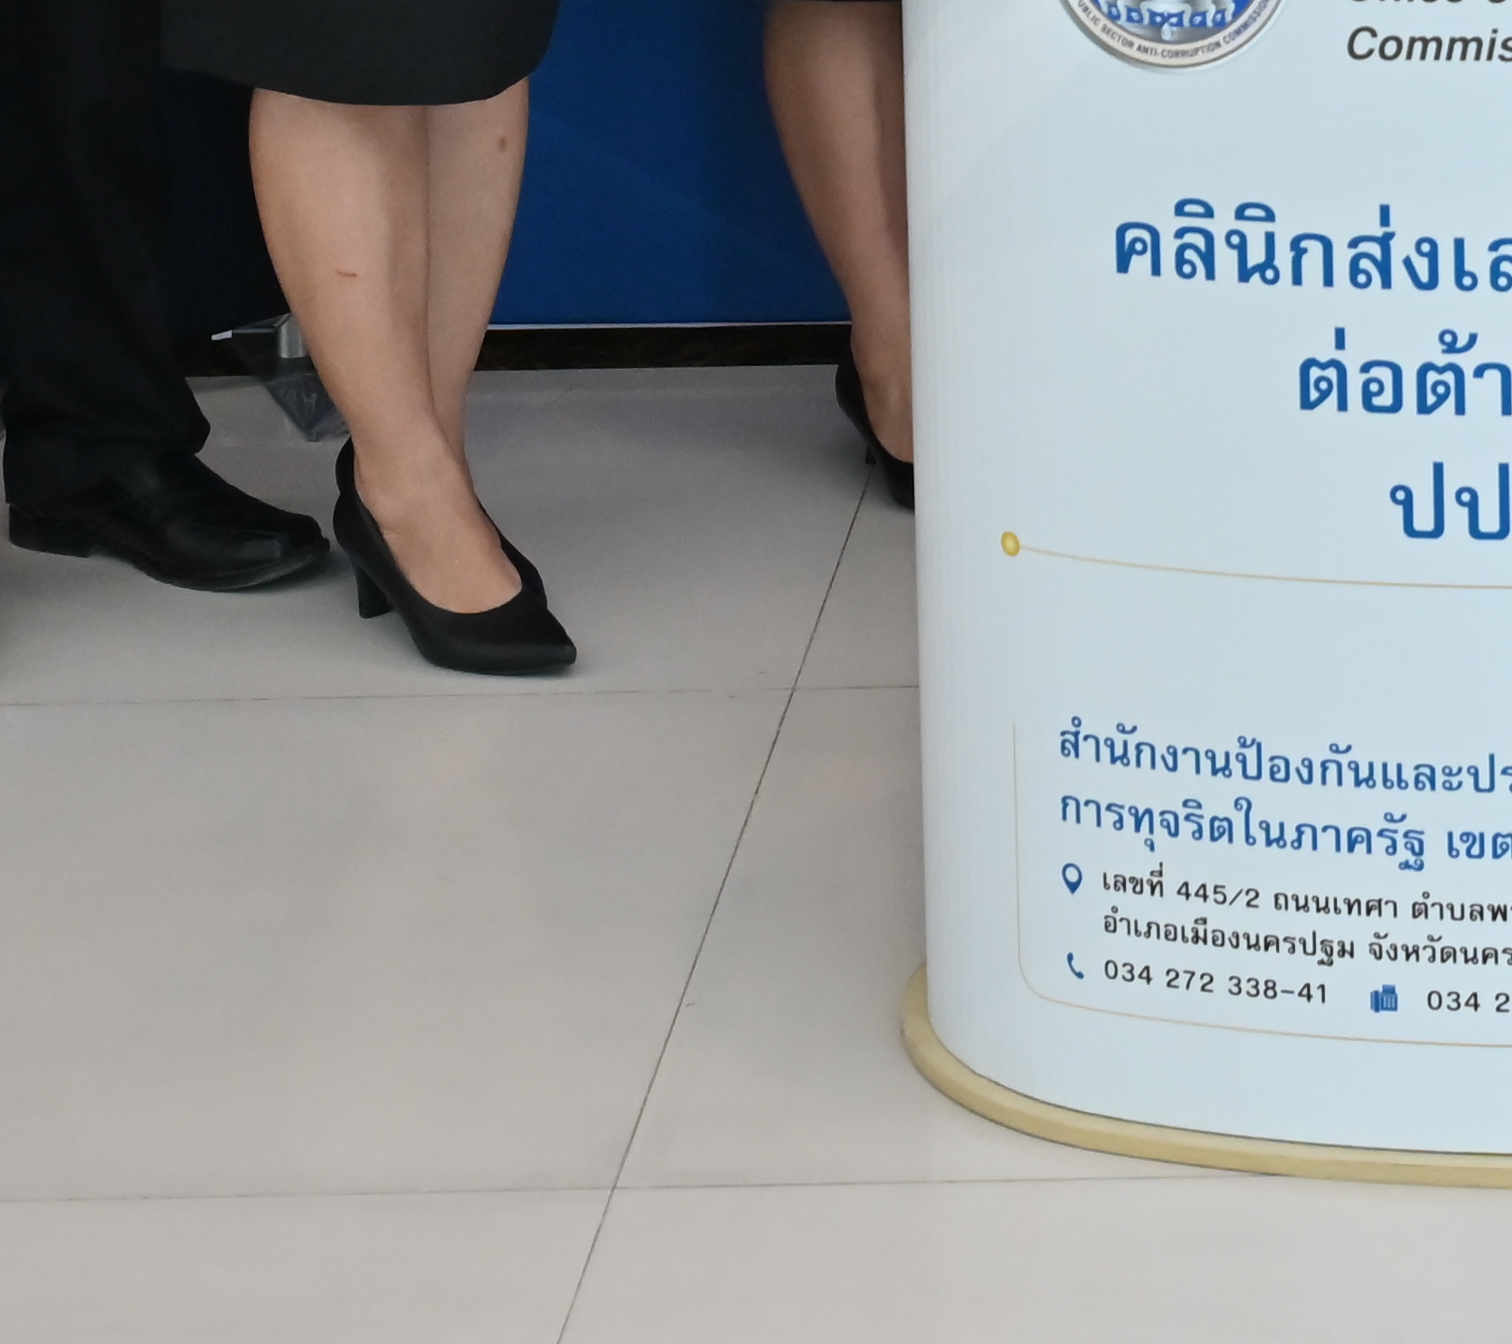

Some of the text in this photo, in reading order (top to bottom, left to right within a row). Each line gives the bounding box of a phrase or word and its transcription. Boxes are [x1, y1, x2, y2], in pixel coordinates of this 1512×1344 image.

[1060, 794, 1426, 872] การทุจริตในภาครัฐ
[1102, 862, 1165, 898] เลขที่
[1176, 880, 1261, 909] 445/2
[1273, 891, 1398, 919] ถนนเทศา
[1103, 905, 1355, 967] อำเภอเมืองนครปฐม
[1103, 959, 1153, 986] 034
[1165, 968, 1215, 994] 272
[1426, 989, 1482, 1012] 034
